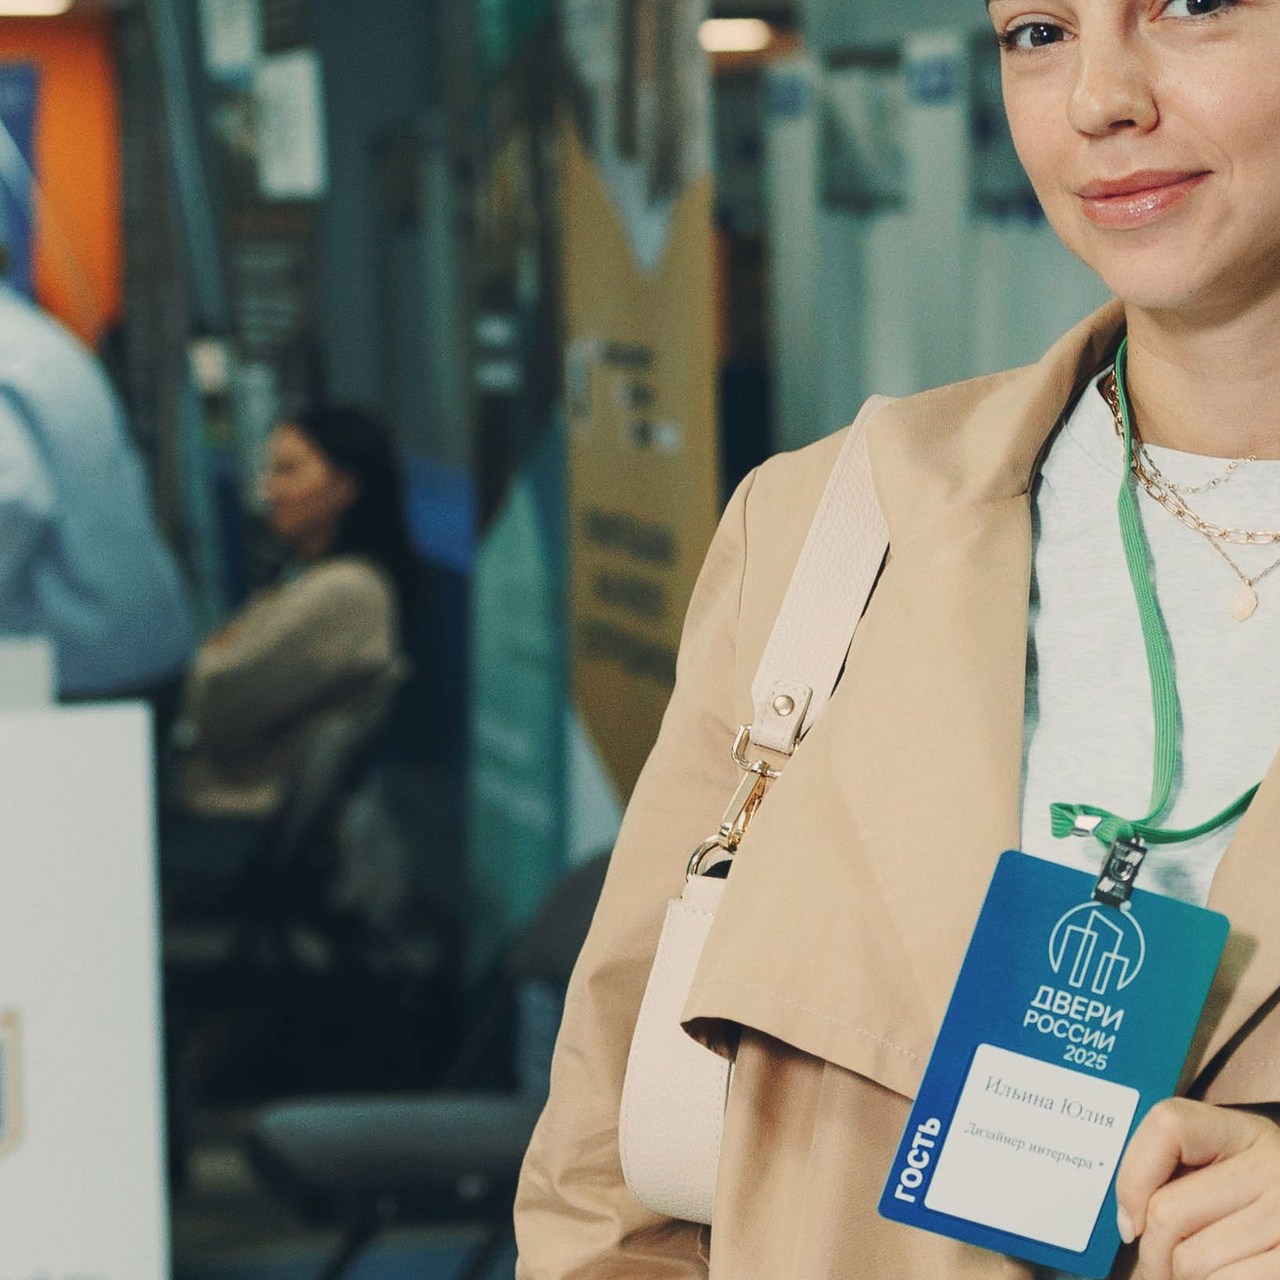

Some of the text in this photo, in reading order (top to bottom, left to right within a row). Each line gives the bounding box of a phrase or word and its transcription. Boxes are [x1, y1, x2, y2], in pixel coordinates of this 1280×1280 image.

[1023, 1009, 1116, 1053] РОССИИ
[1030, 985, 1124, 1031] ДВЕРИ
[1063, 1044, 1108, 1071] 2025
[984, 1075, 1115, 1129] Ильина Юлия
[894, 1117, 941, 1204] ГОСТЬ
[963, 1122, 1093, 1170] Дизайнер интерьера
